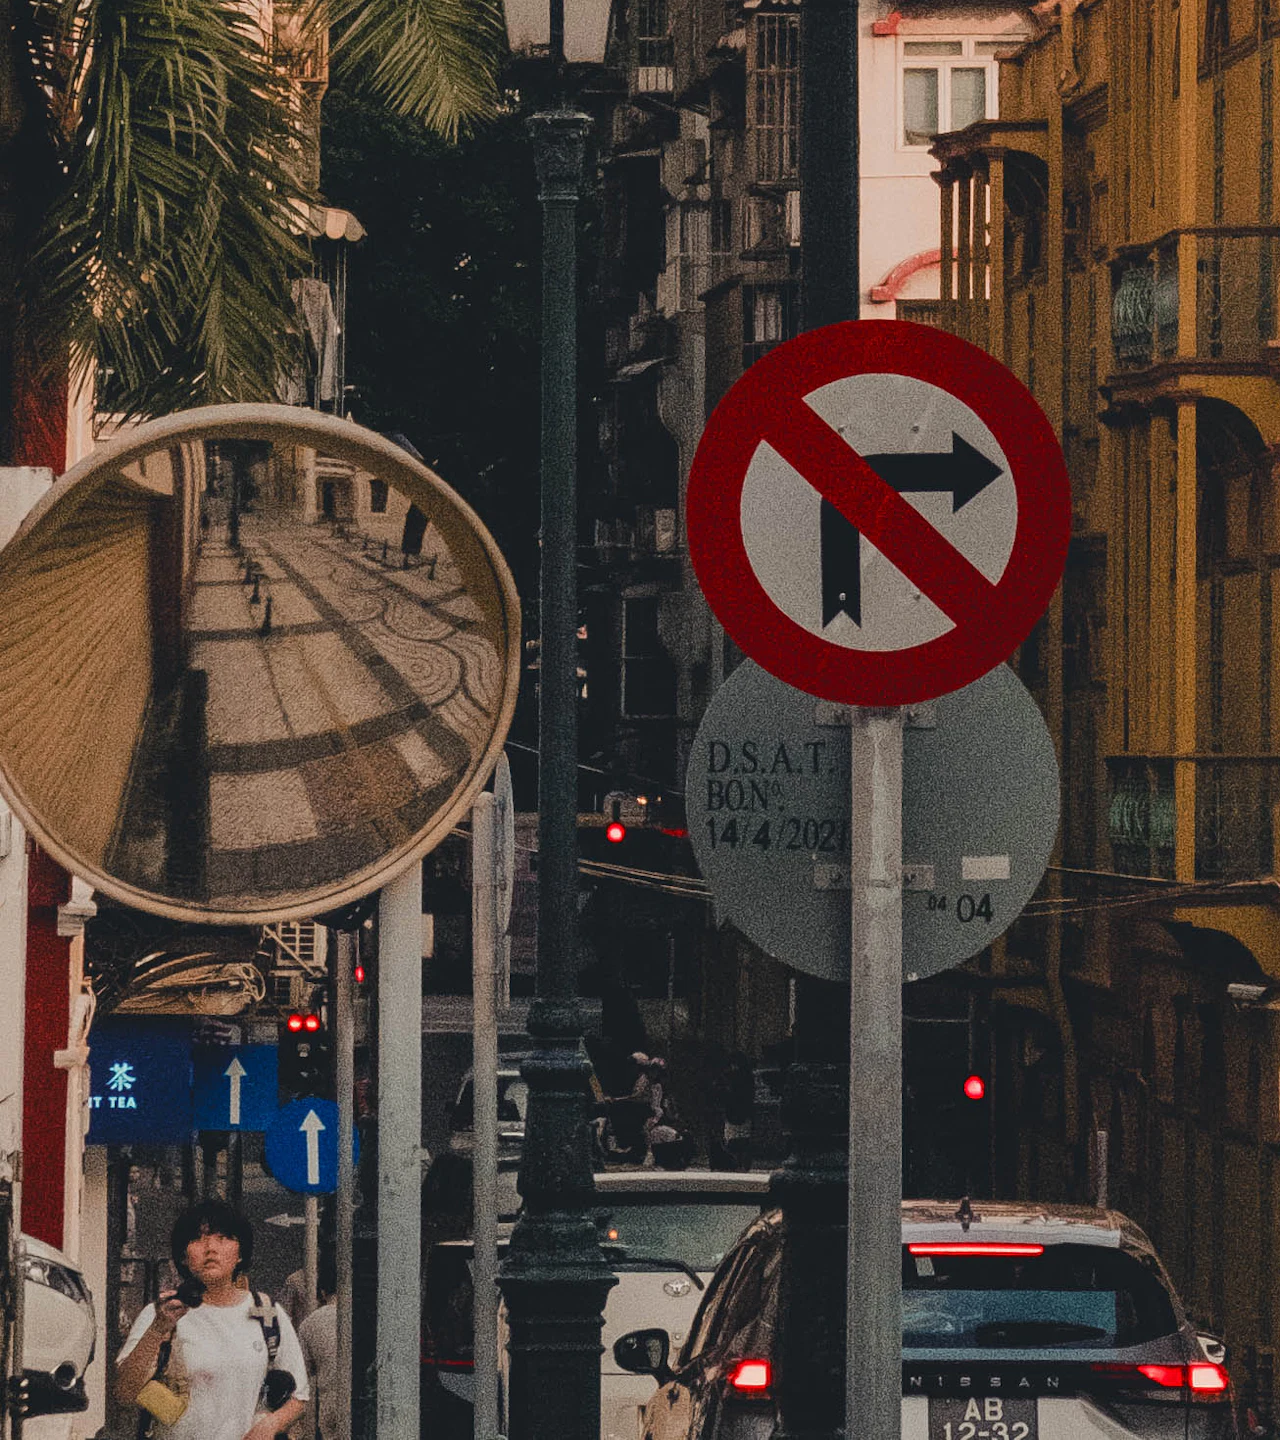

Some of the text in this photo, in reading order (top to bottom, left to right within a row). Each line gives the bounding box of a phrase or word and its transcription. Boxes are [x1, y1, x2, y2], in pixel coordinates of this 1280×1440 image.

[708, 740, 835, 774] D.S.A.T.
[957, 893, 994, 924] 04
[106, 1062, 137, 1092] 茶
[108, 1096, 137, 1109] TEA
[910, 1376, 1060, 1388] NISSAN
[963, 1397, 1004, 1422] AB
[943, 1421, 1030, 1440] 12-32
